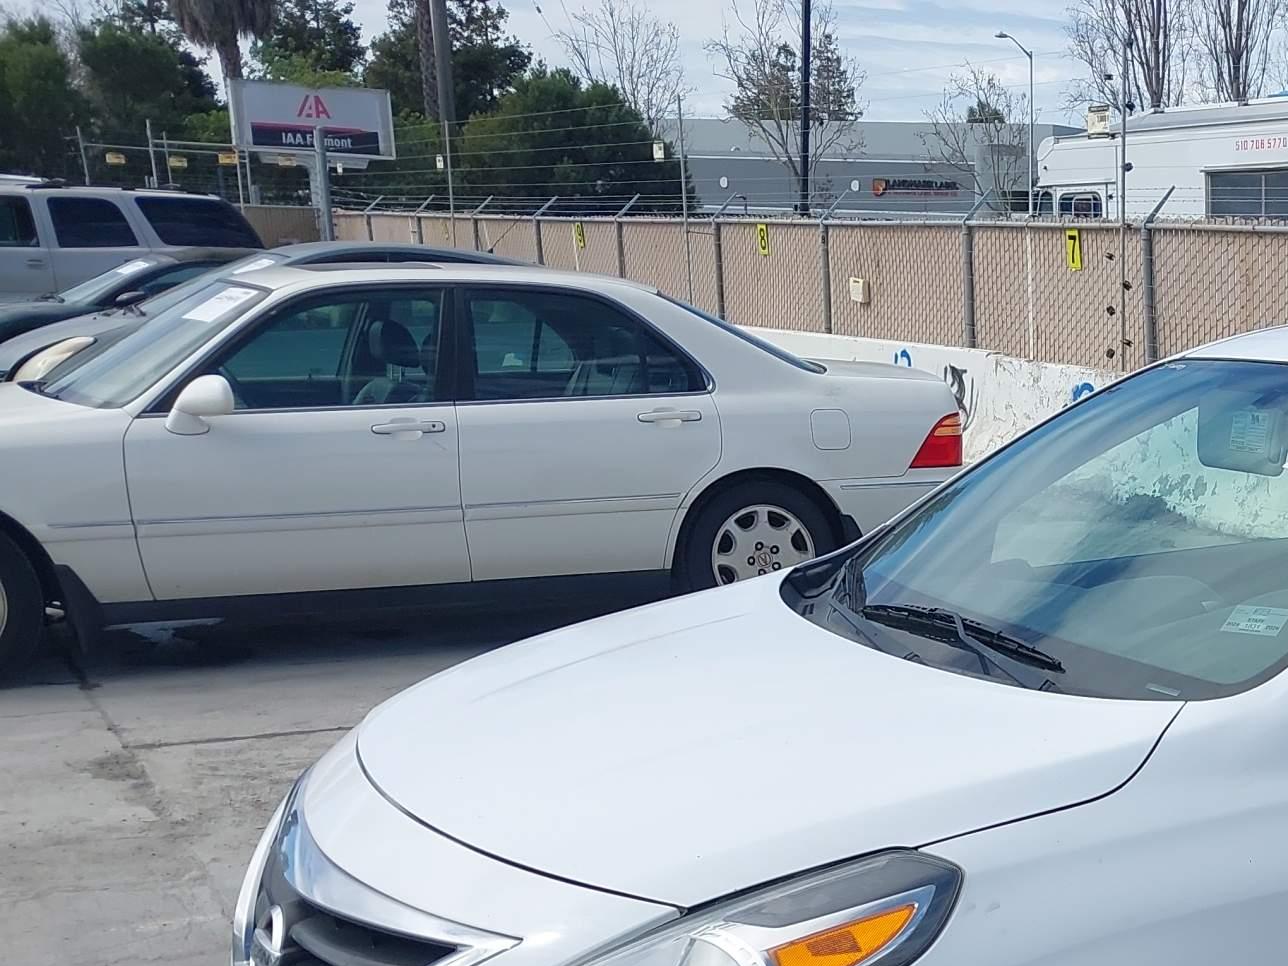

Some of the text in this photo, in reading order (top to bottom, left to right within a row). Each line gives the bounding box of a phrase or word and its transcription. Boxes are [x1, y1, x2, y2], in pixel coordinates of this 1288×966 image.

[282, 132, 352, 148] IAA Fmont
[1235, 140, 1248, 151] 510
[1267, 137, 1288, 149] 5770
[759, 228, 767, 250] 8
[1068, 235, 1077, 264] 7
